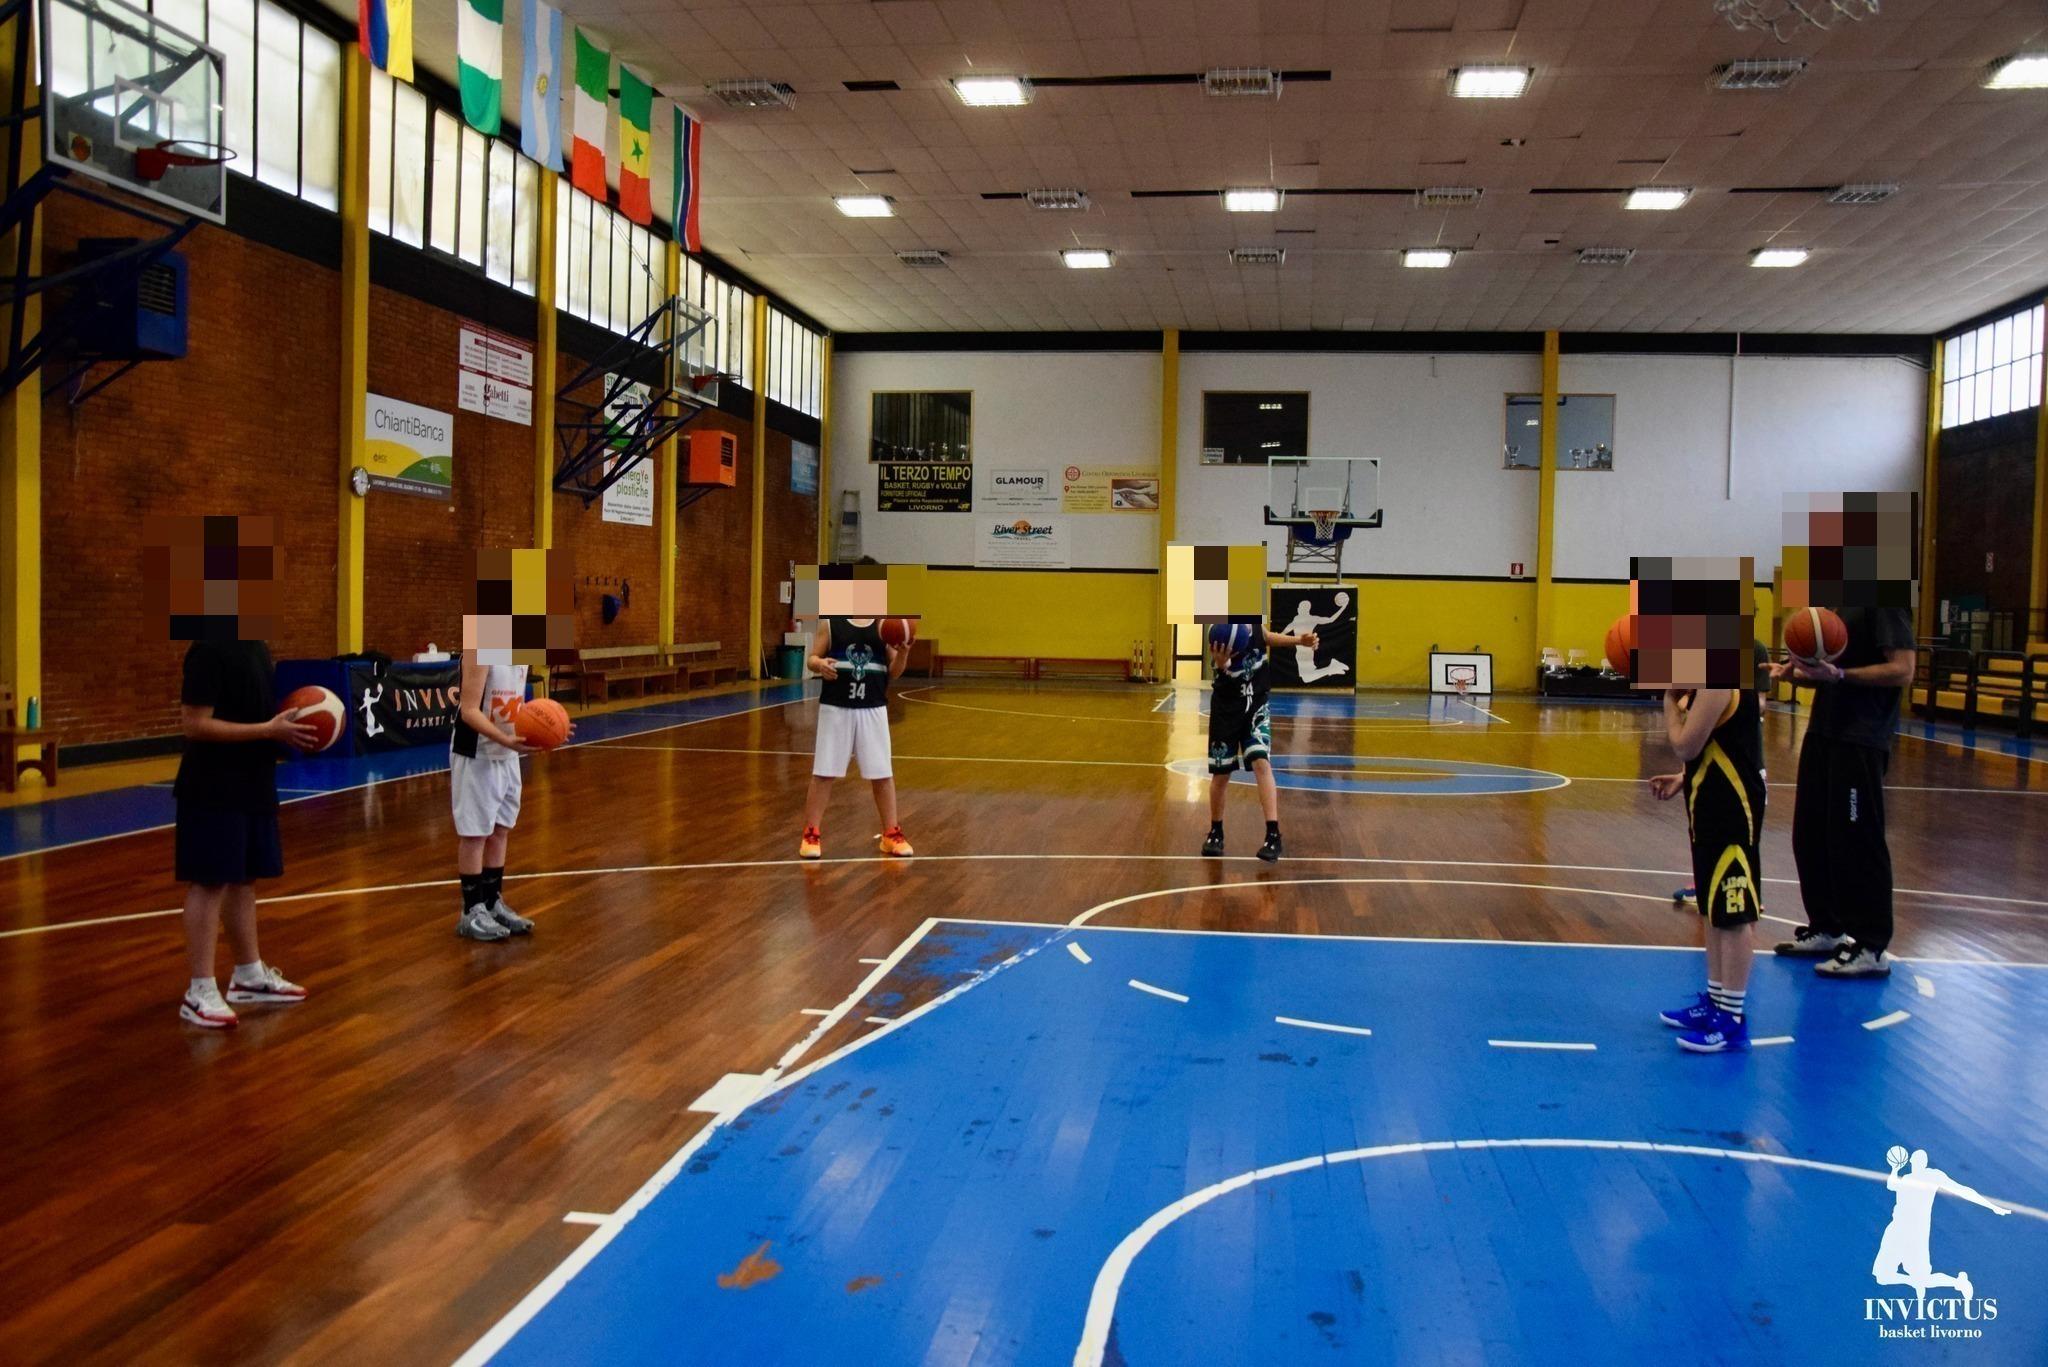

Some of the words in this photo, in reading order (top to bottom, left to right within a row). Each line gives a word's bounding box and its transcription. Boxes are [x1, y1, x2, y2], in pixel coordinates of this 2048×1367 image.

[374, 409, 444, 441] ChiantiBanca
[880, 466, 890, 480] IL
[893, 466, 929, 480] TERZO
[932, 466, 971, 480] TEMPO
[616, 482, 649, 498] plastiche
[993, 524, 1020, 534] River
[1022, 525, 1053, 534] Street
[394, 686, 460, 712] INVIC
[848, 682, 866, 700] 34
[406, 715, 446, 729] BASKET
